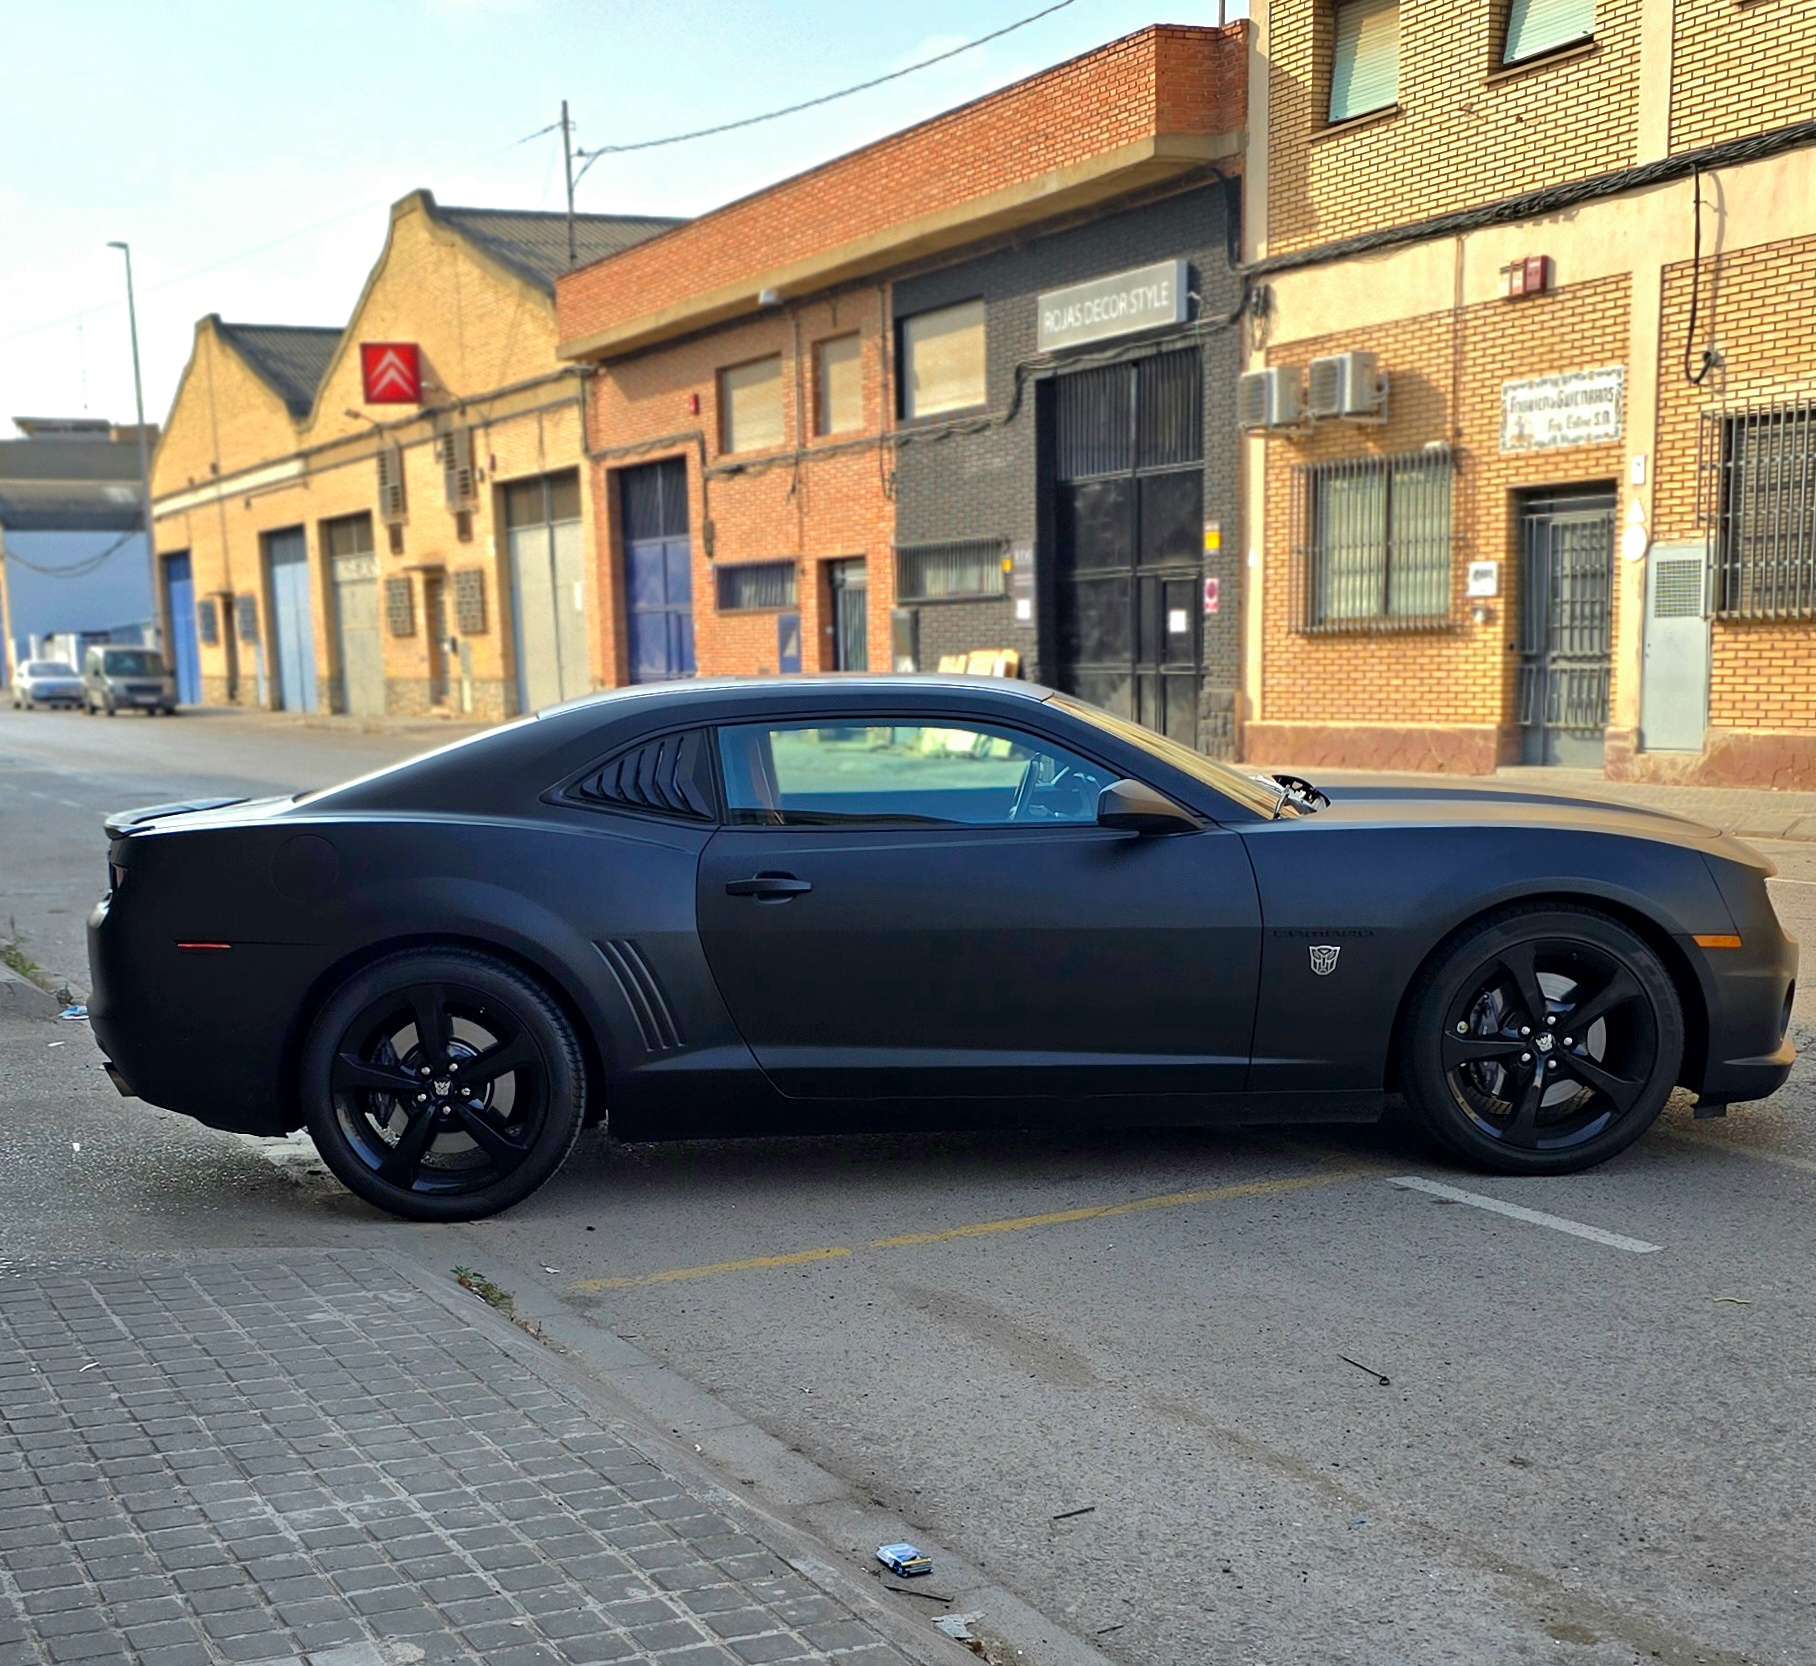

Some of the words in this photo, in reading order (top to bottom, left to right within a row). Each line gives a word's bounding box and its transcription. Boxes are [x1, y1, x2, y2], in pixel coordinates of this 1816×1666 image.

[1043, 303, 1082, 334] ROJAS
[1084, 292, 1127, 324] DECOR
[1129, 281, 1169, 314] STYLE
